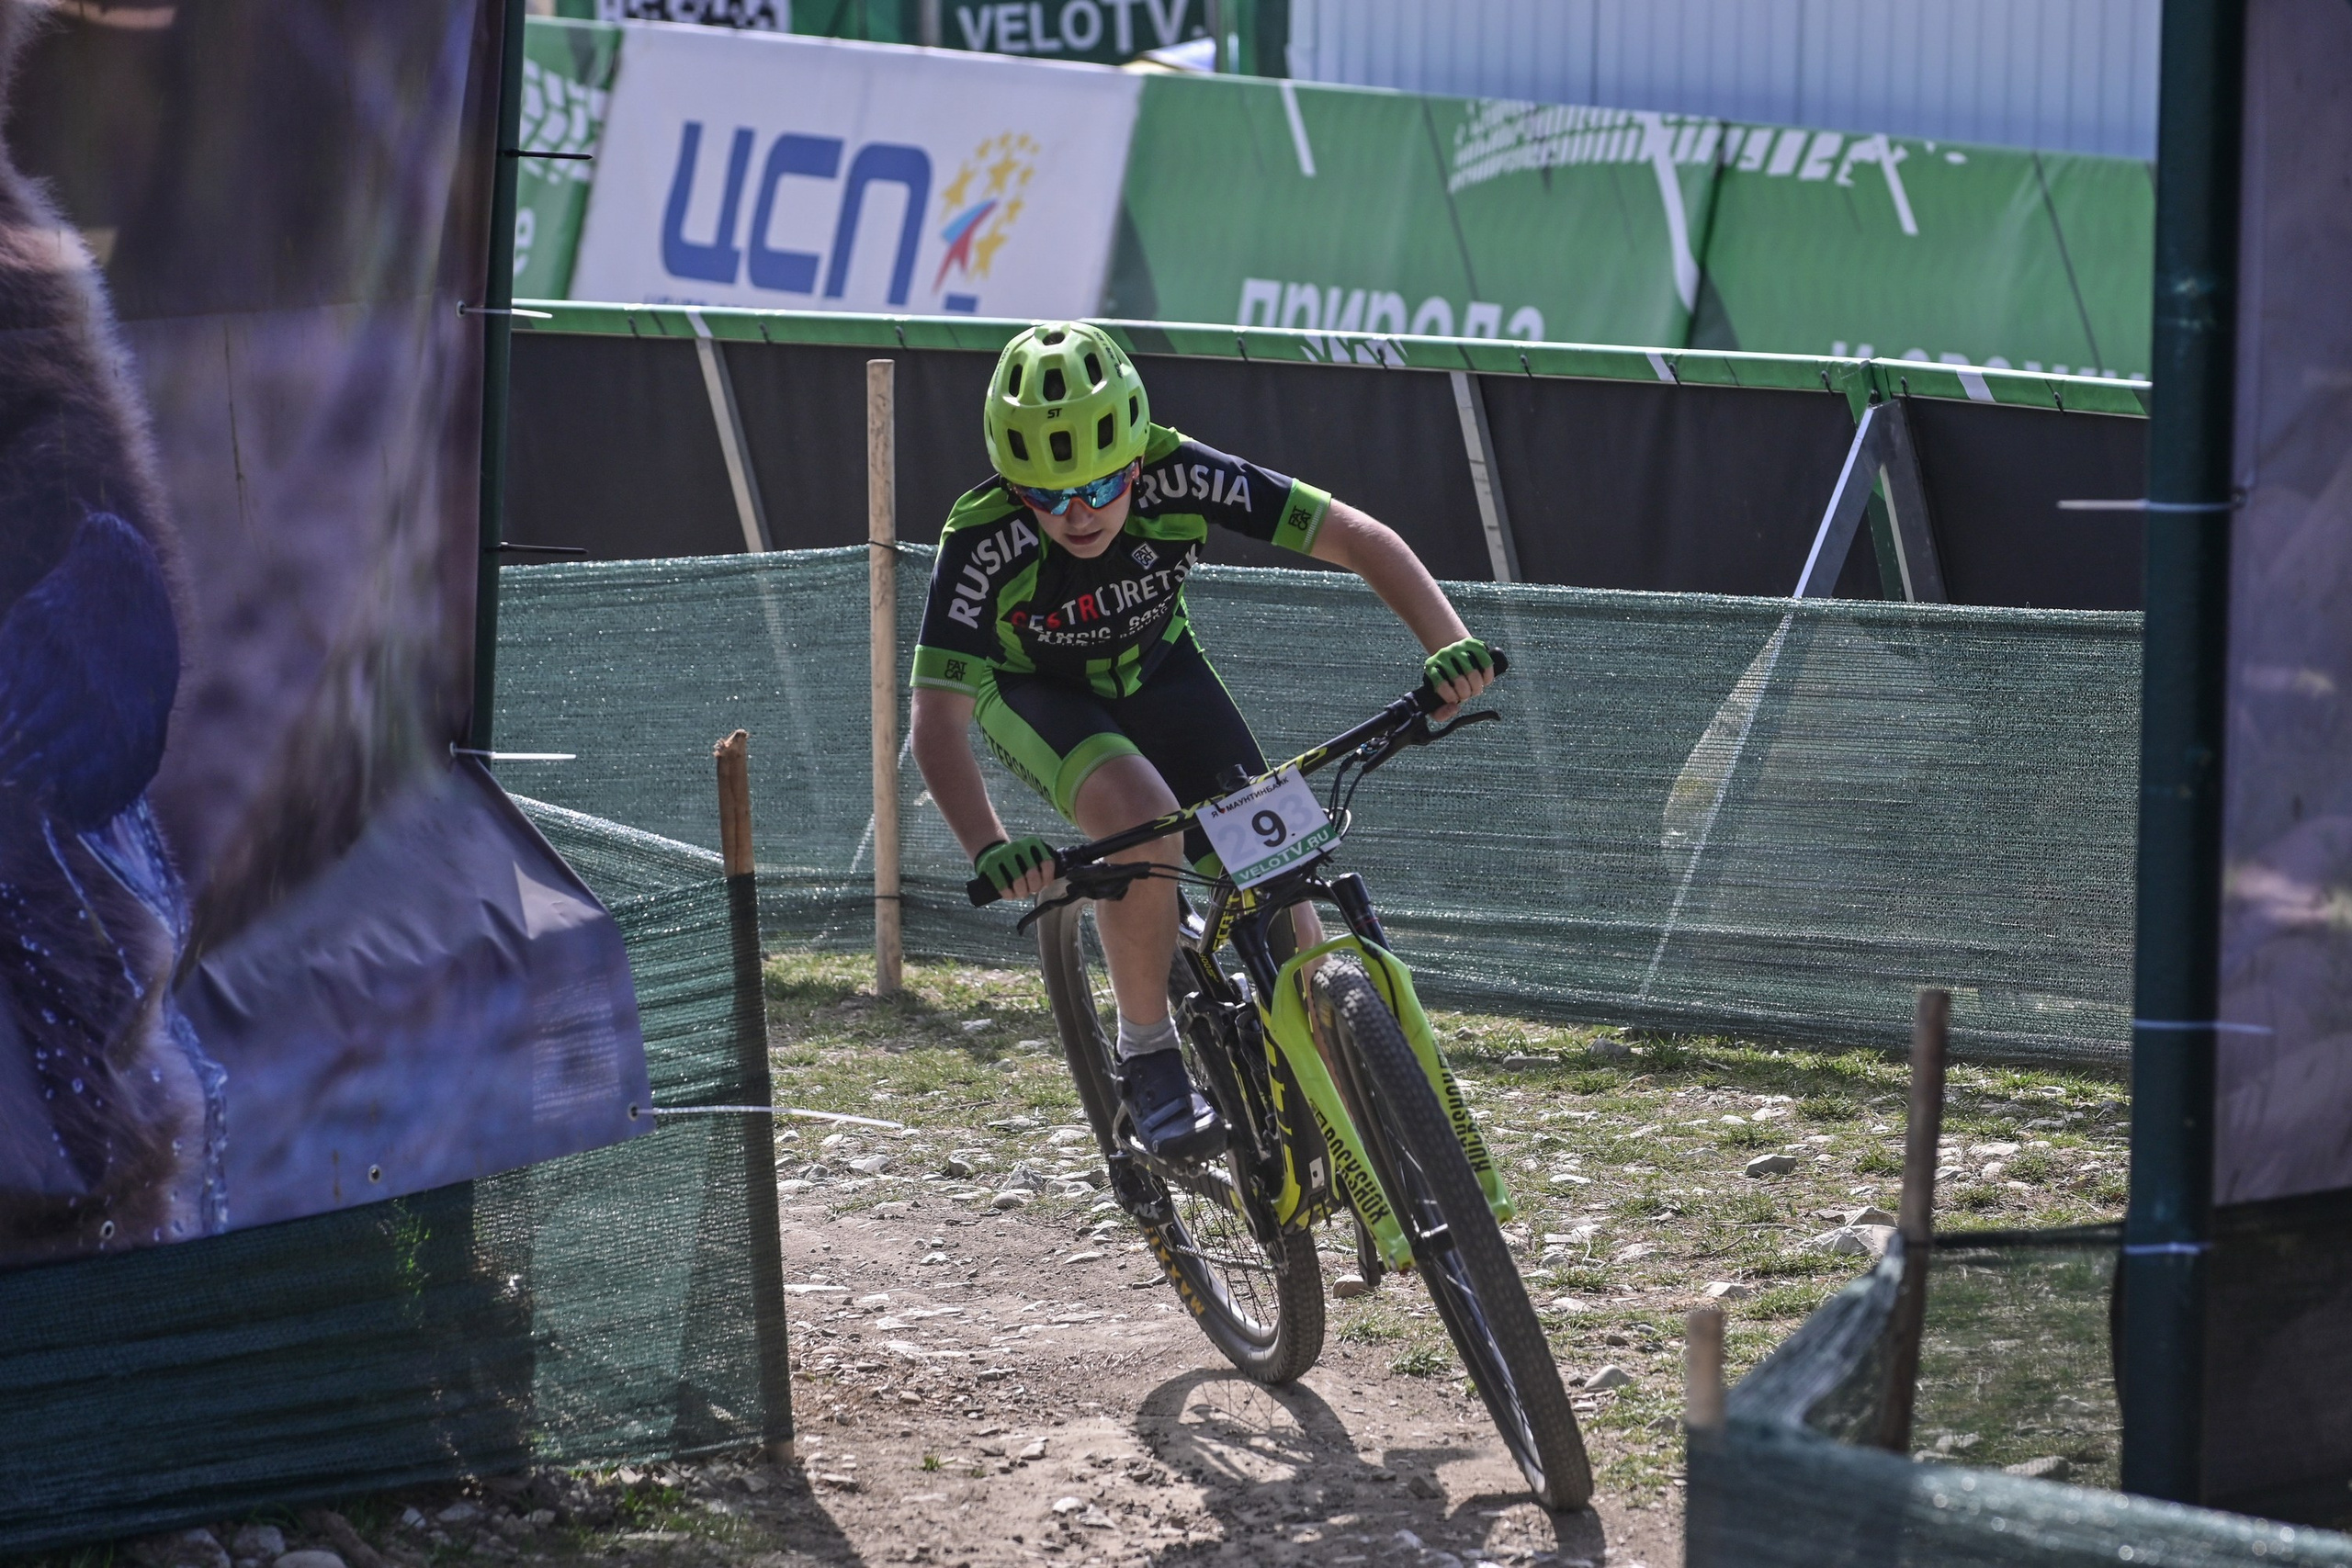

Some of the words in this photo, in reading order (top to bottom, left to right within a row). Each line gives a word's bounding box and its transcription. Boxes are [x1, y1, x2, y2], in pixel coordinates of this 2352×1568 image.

[944, 669, 966, 682] CAT
[947, 659, 967, 671] FAT
[1250, 809, 1287, 848] 9
[1239, 829, 1330, 882] VELOTV.RU
